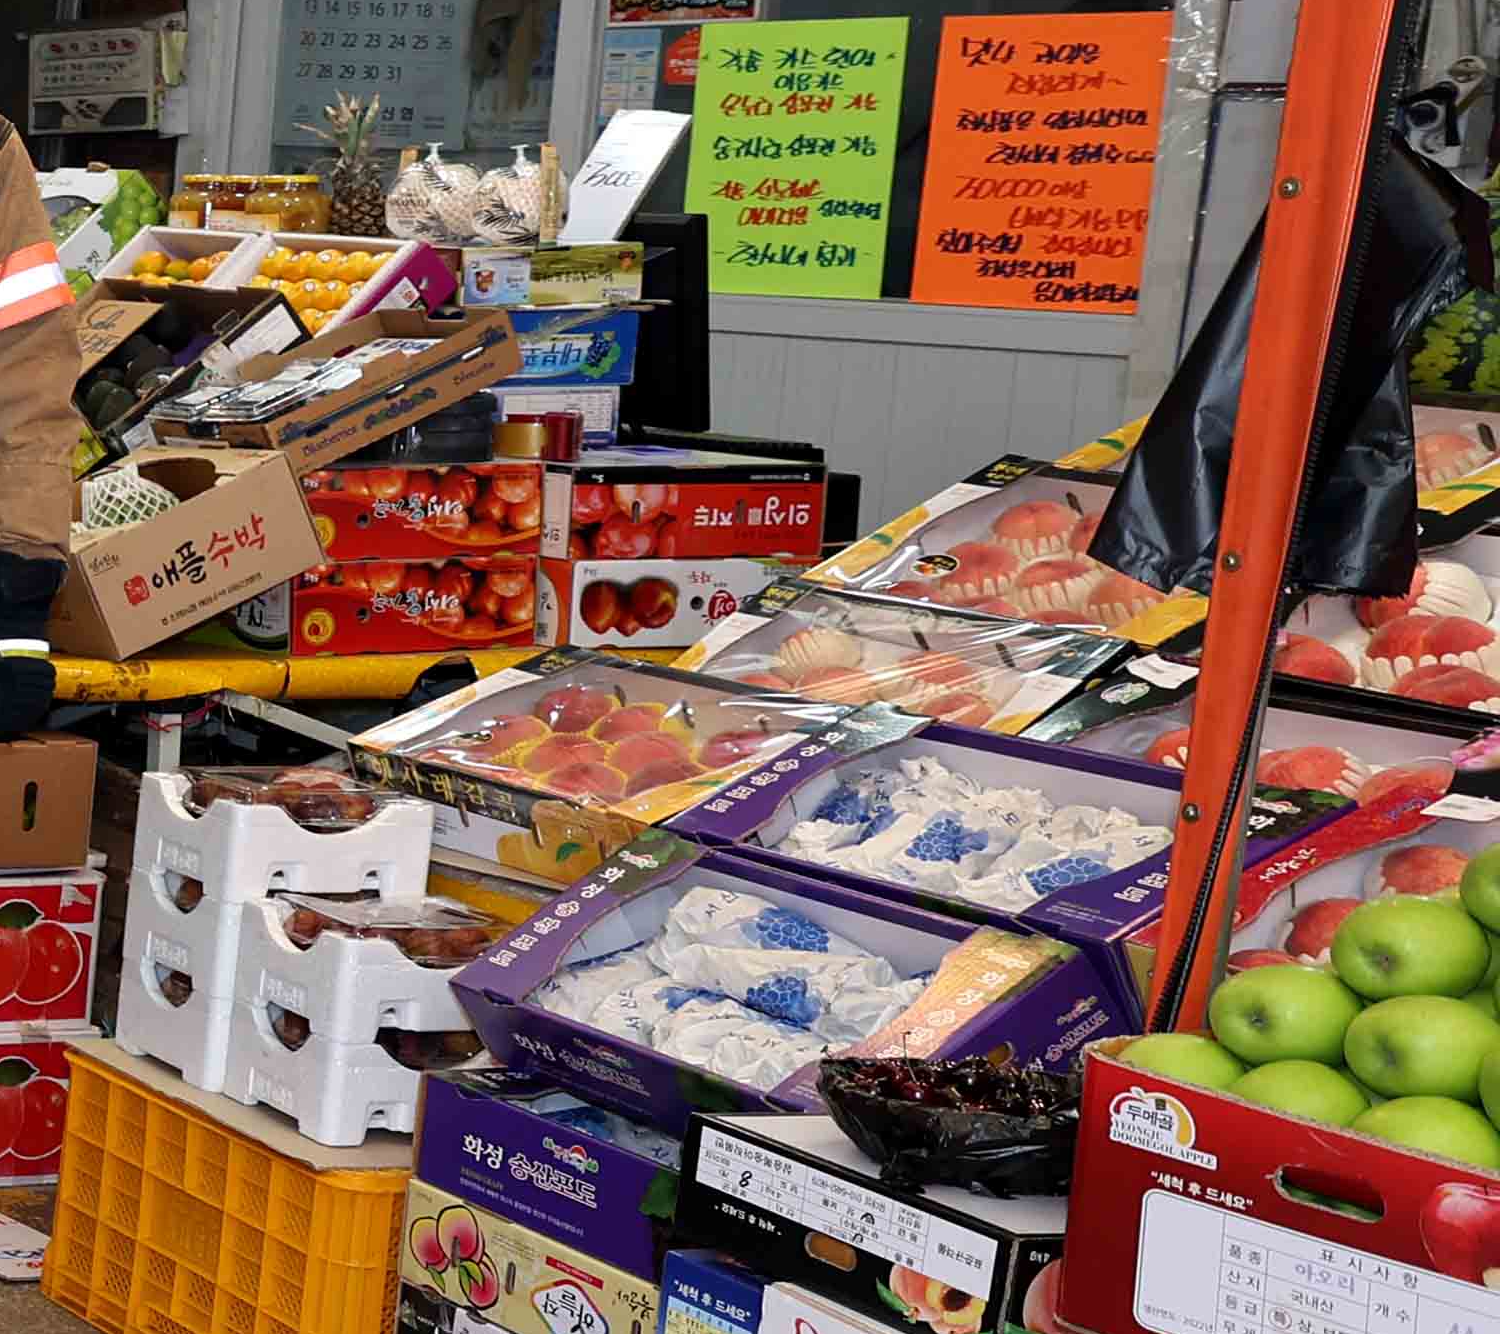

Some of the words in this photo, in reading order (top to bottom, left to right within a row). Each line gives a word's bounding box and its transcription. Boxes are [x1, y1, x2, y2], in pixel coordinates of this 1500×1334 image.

[370, 2, 385, 17] 16
[393, 2, 408, 17] 17
[299, 30, 316, 46] 20
[320, 31, 335, 46] 21
[341, 32, 358, 47] 22
[364, 33, 380, 48] 23
[387, 34, 405, 49] 24
[412, 35, 429, 50] 25
[317, 63, 333, 78] 28
[339, 64, 356, 79] 29
[362, 65, 379, 80] 30
[387, 65, 402, 80] 31
[152, 516, 269, 590] 애플수박
[1175, 1146, 1216, 1169] APPLE
[461, 1134, 503, 1170] 화성
[507, 1153, 598, 1209] 송산포도
[1188, 1182, 1202, 1198] 후
[1289, 1287, 1334, 1316] 국내산
